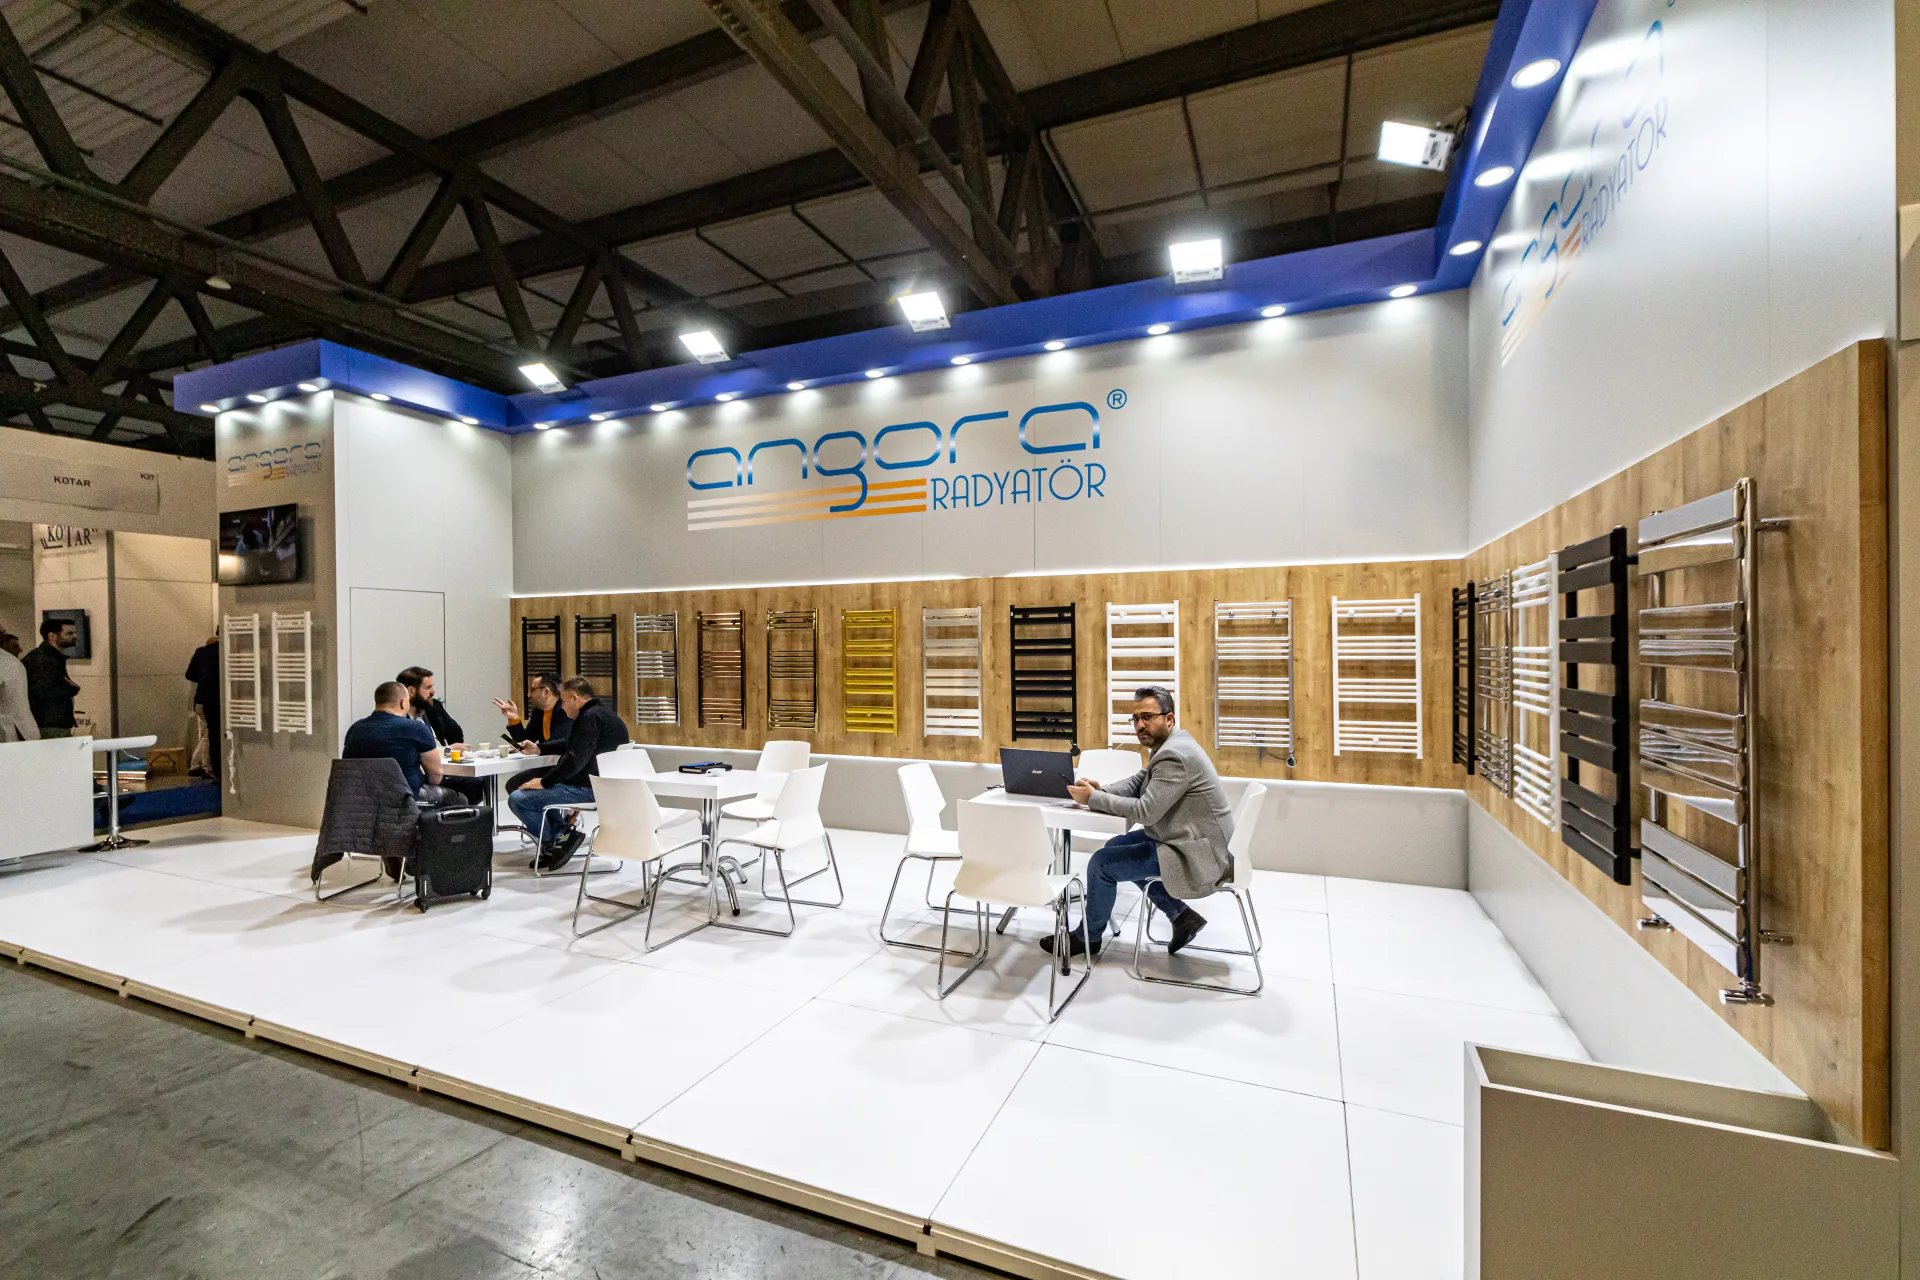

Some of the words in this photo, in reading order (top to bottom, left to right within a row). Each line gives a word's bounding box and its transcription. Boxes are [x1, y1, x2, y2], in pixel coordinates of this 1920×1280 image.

[53, 475, 91, 487] KOTAR
[687, 401, 1100, 512] angora
[931, 458, 1106, 510] RADYATÖR
